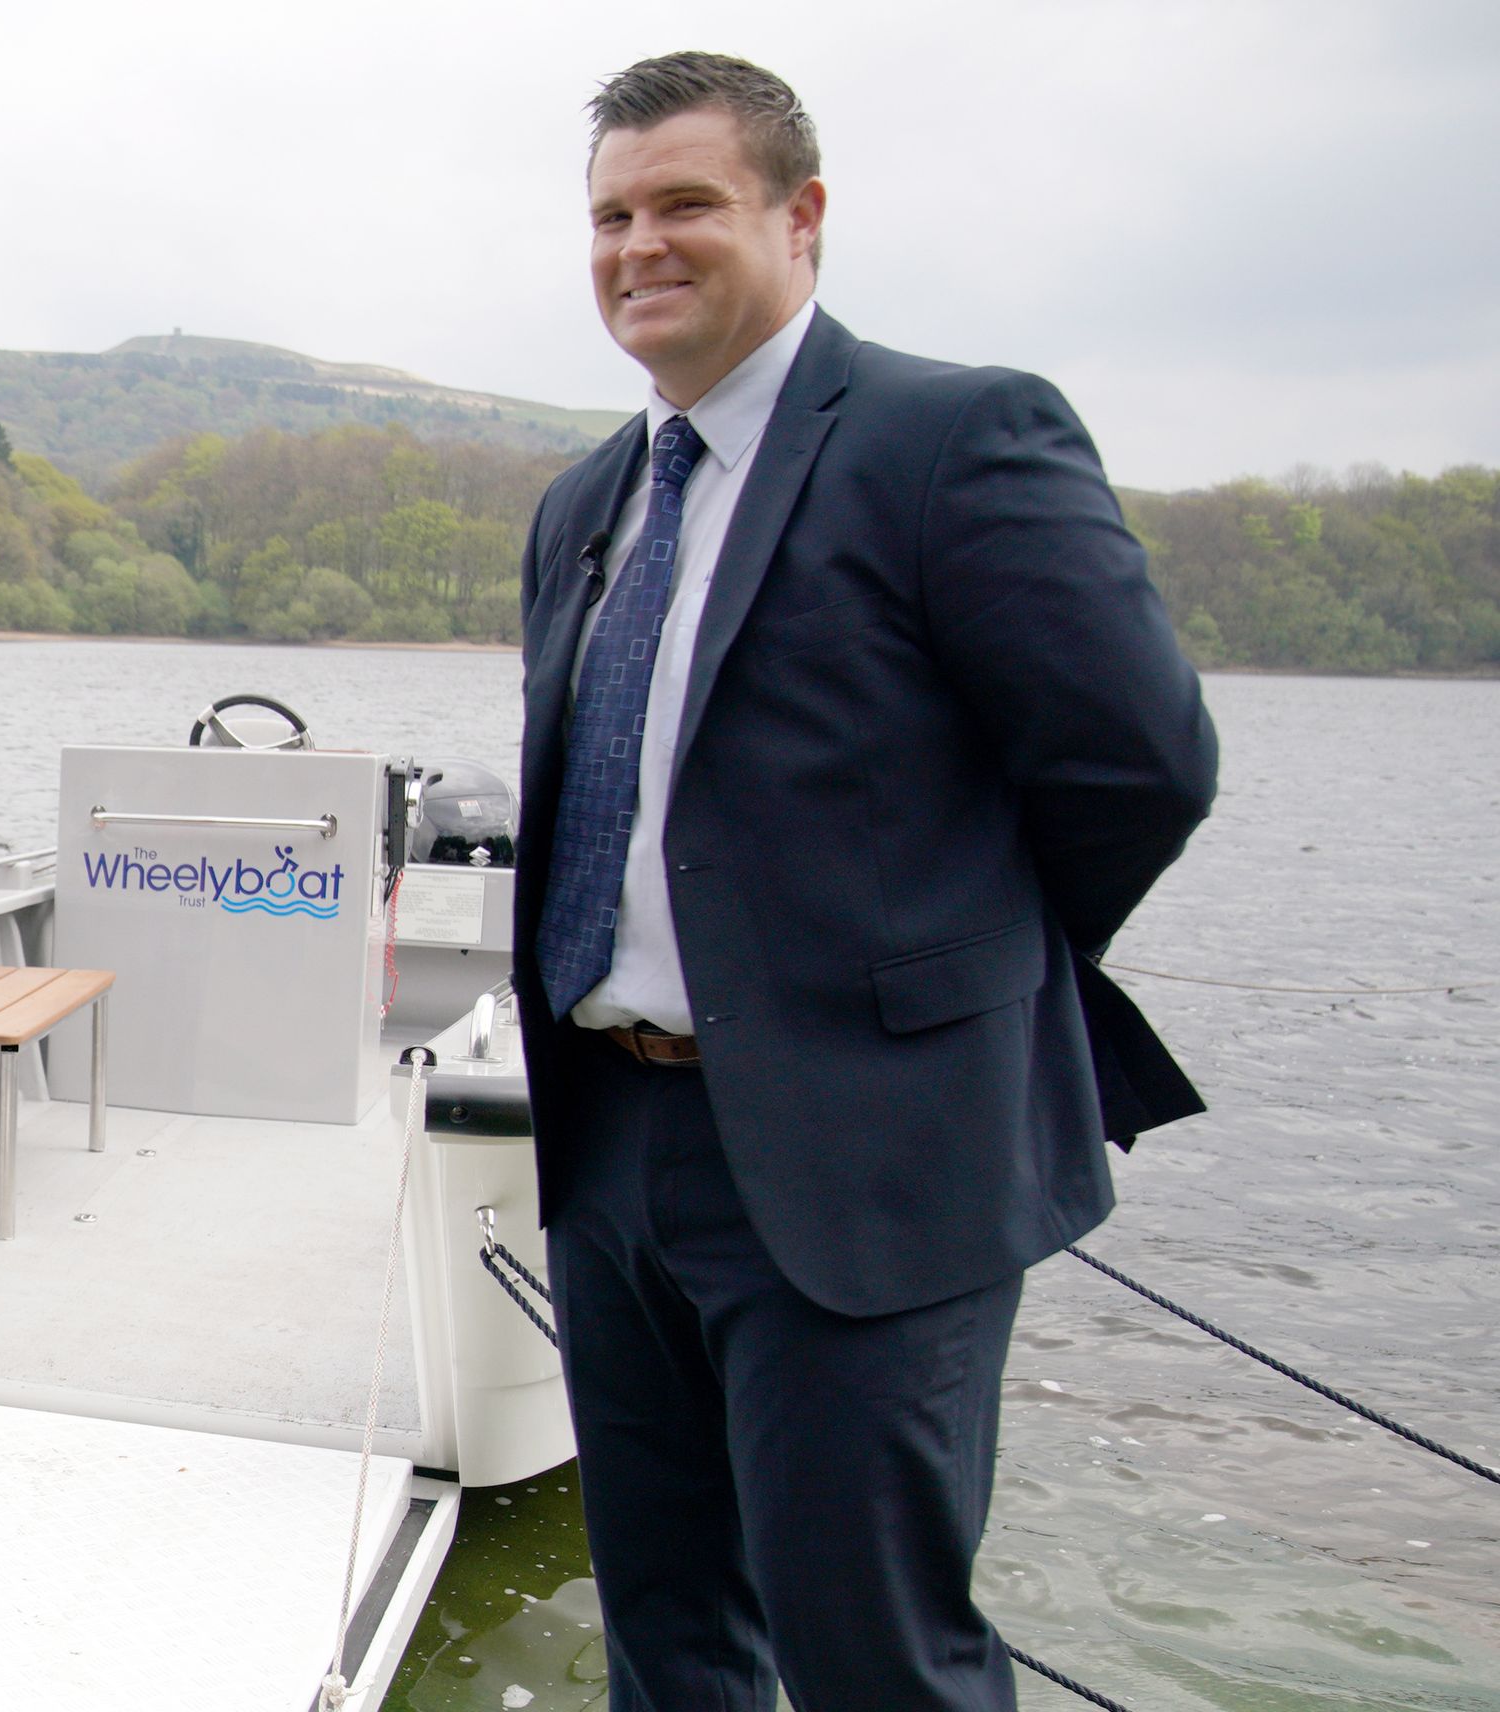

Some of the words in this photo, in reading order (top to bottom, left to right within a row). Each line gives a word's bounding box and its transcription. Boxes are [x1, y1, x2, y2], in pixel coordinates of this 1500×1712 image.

[133, 847, 158, 861] The
[83, 851, 345, 901] Wheelyboat
[178, 895, 206, 908] Trust
